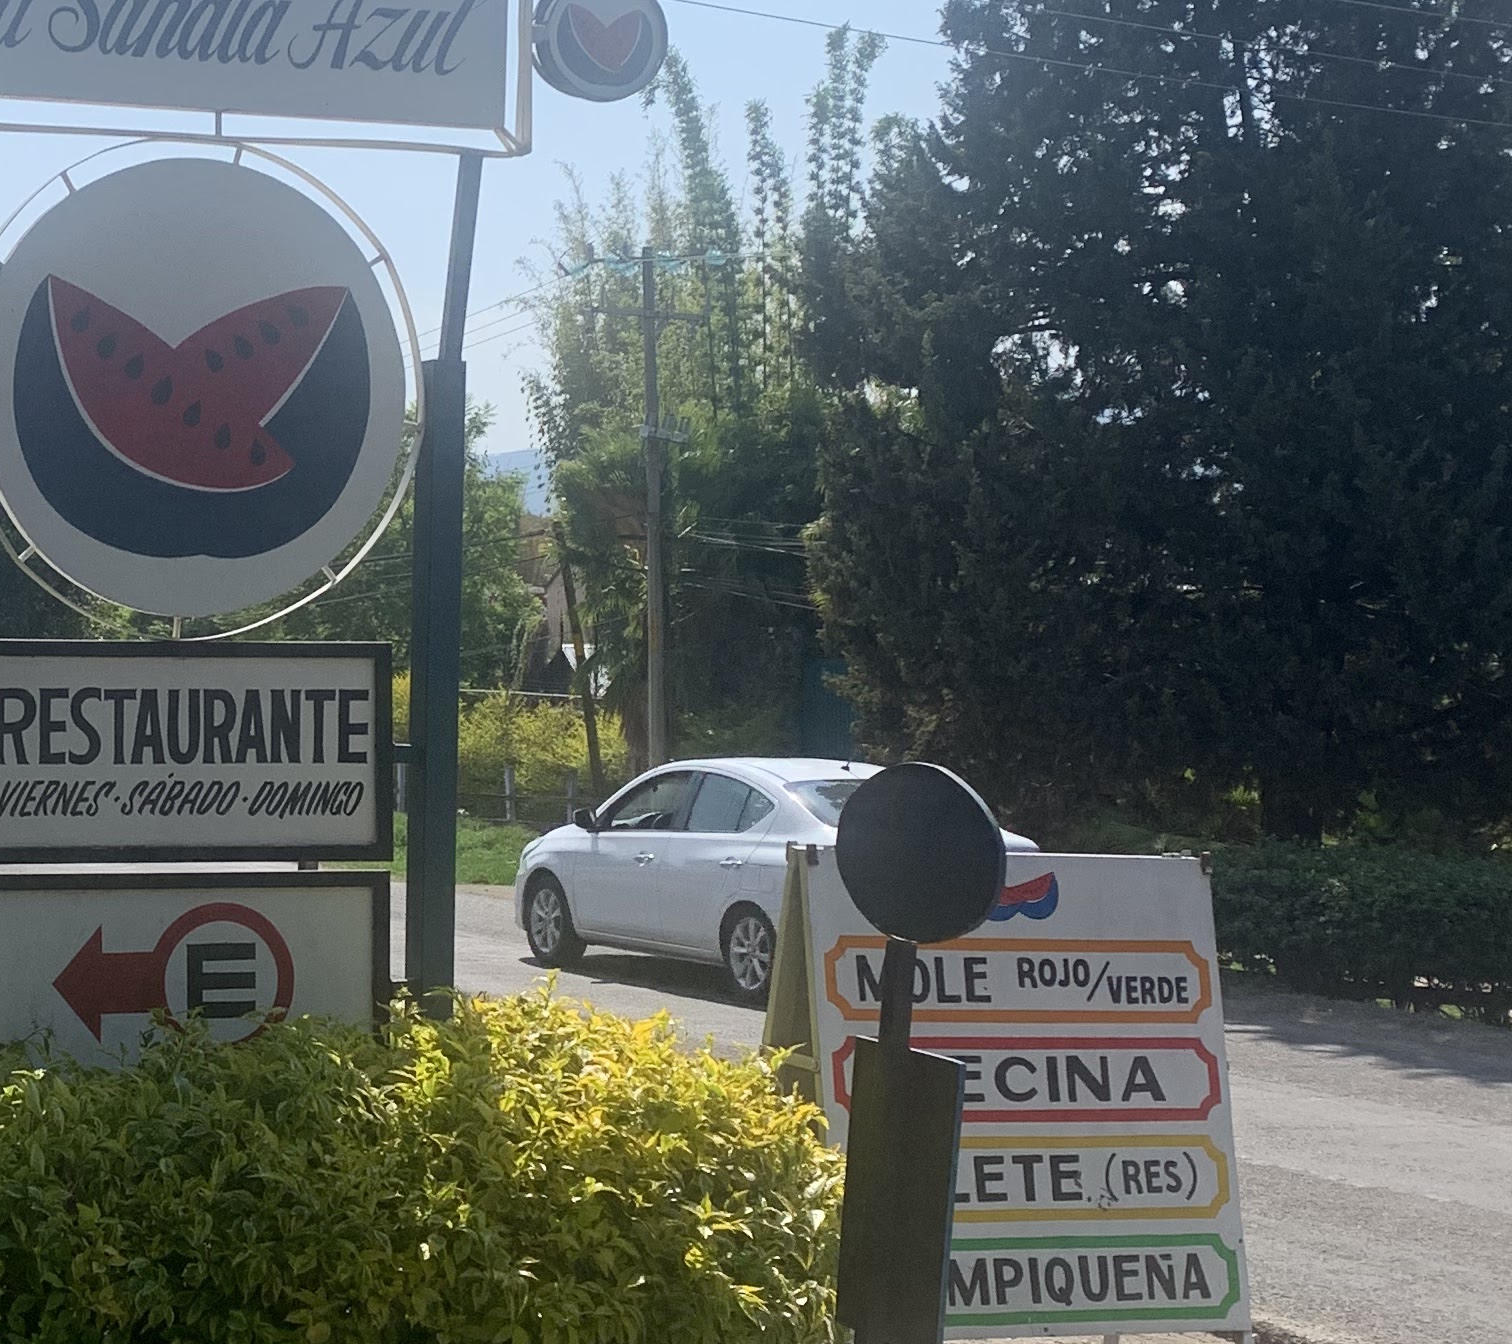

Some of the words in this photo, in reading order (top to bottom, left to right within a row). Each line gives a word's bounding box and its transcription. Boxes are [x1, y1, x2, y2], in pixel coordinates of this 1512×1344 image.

[247, 779, 365, 820] DOMINGO
[186, 941, 257, 1019] E
[947, 1054, 1167, 1104] ECINA
[1104, 1151, 1198, 1202] (RES)
[947, 1252, 1213, 1307] MPIQUEÑA
